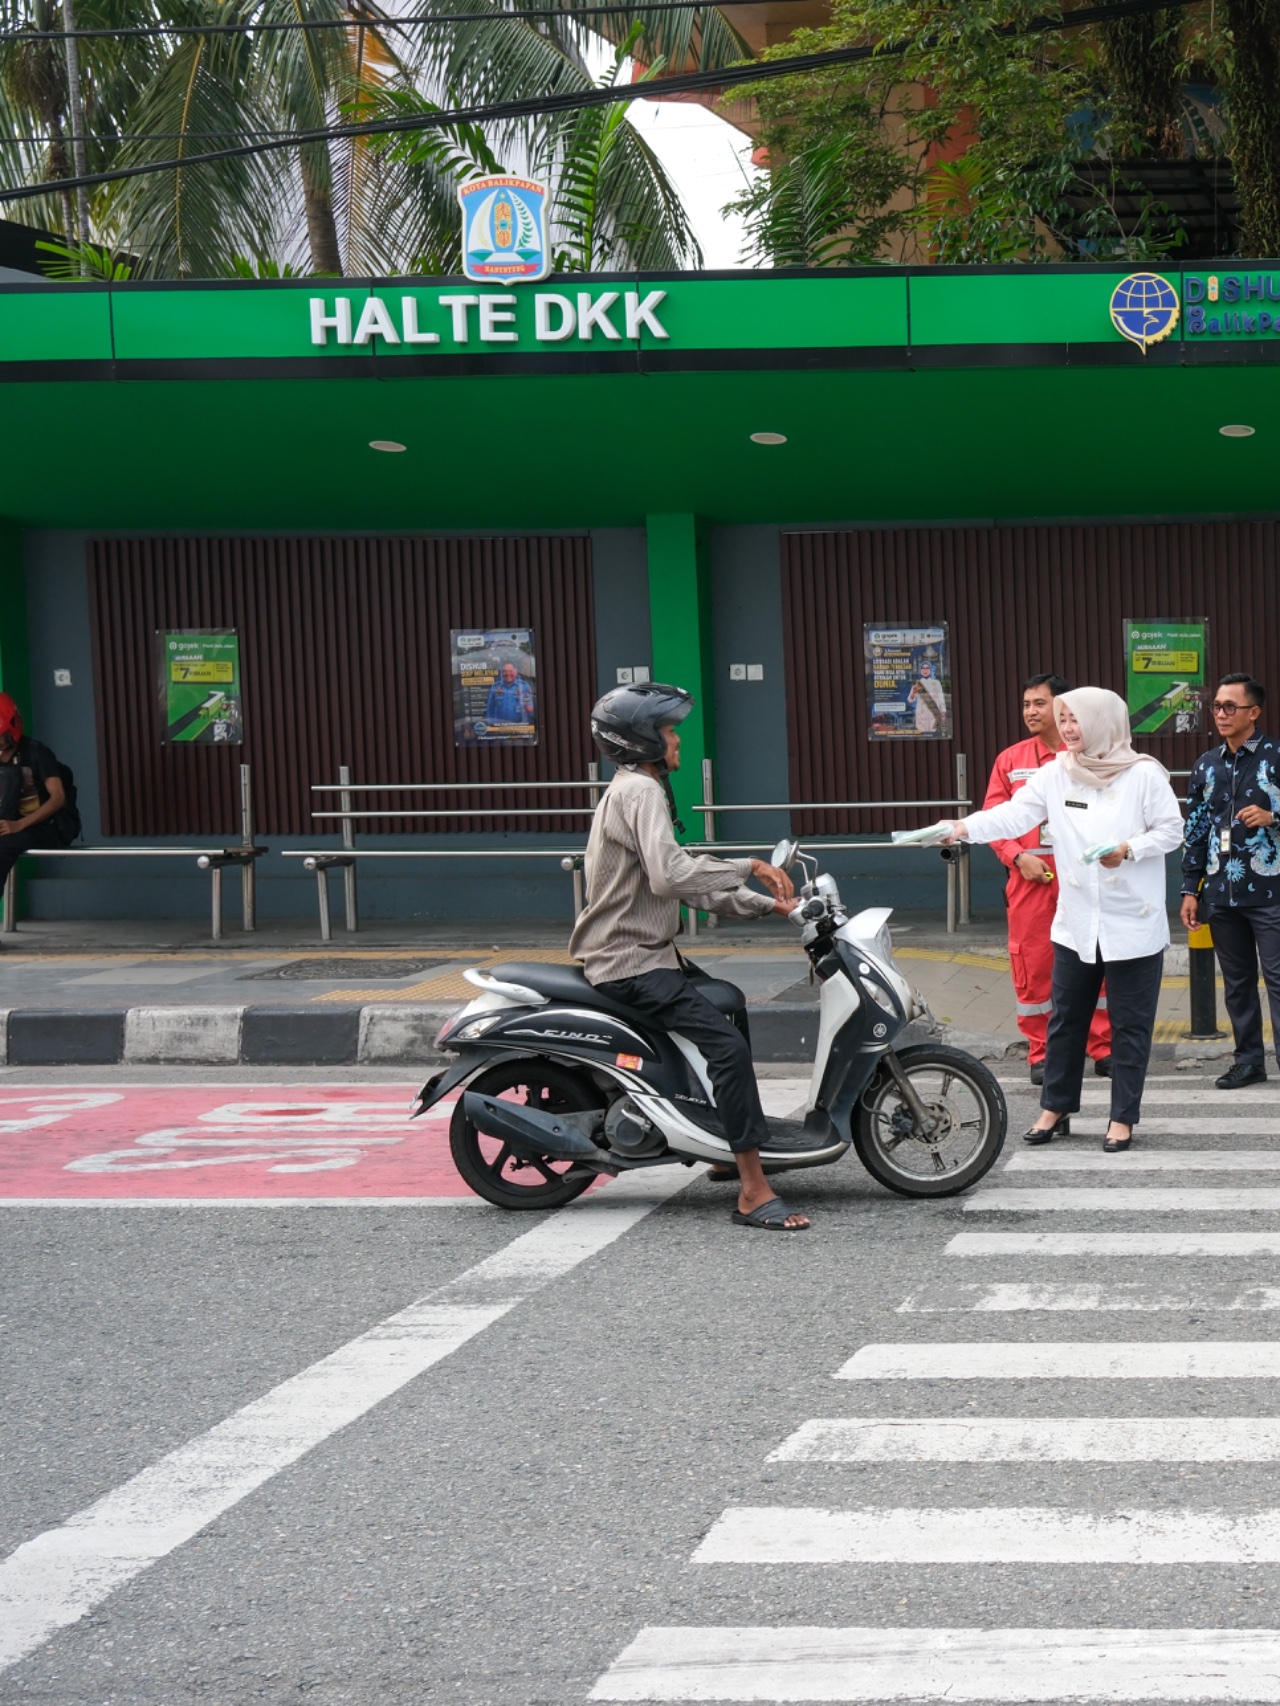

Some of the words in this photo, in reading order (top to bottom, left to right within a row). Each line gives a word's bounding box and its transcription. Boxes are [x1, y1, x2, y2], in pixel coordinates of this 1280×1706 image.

[463, 181, 487, 195] KOTA
[489, 179, 542, 193] BALIKPAPAN
[309, 294, 518, 346] HALTE
[534, 290, 670, 342] DKK
[1142, 631, 1163, 640] gojek
[179, 641, 199, 651] gojek
[1142, 657, 1152, 670] 7
[180, 667, 190, 679] 7
[542, 1028, 601, 1042] FINO
